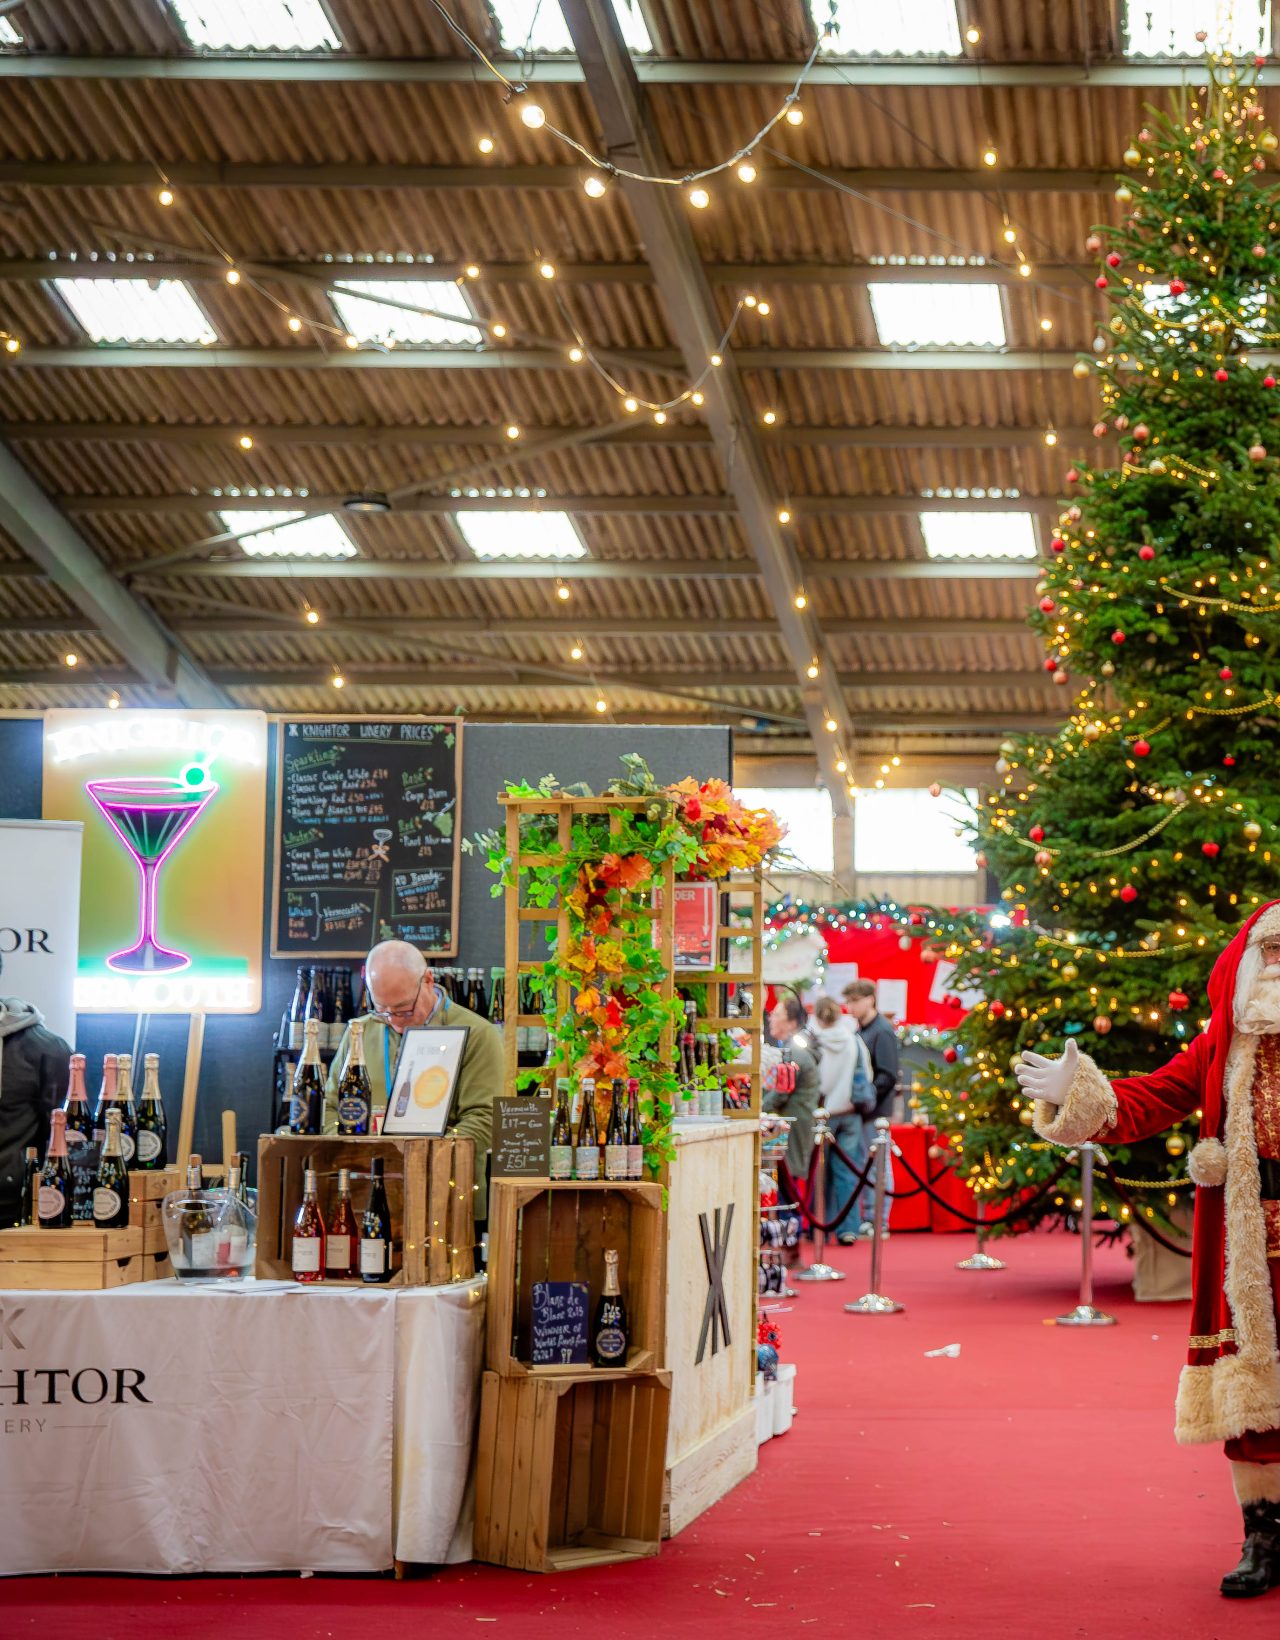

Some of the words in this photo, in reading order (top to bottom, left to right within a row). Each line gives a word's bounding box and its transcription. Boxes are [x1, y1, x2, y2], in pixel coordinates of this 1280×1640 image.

[302, 724, 350, 737] KNIGHTOR
[401, 725, 434, 740] PRICES
[500, 1101, 539, 1113] Vermouth
